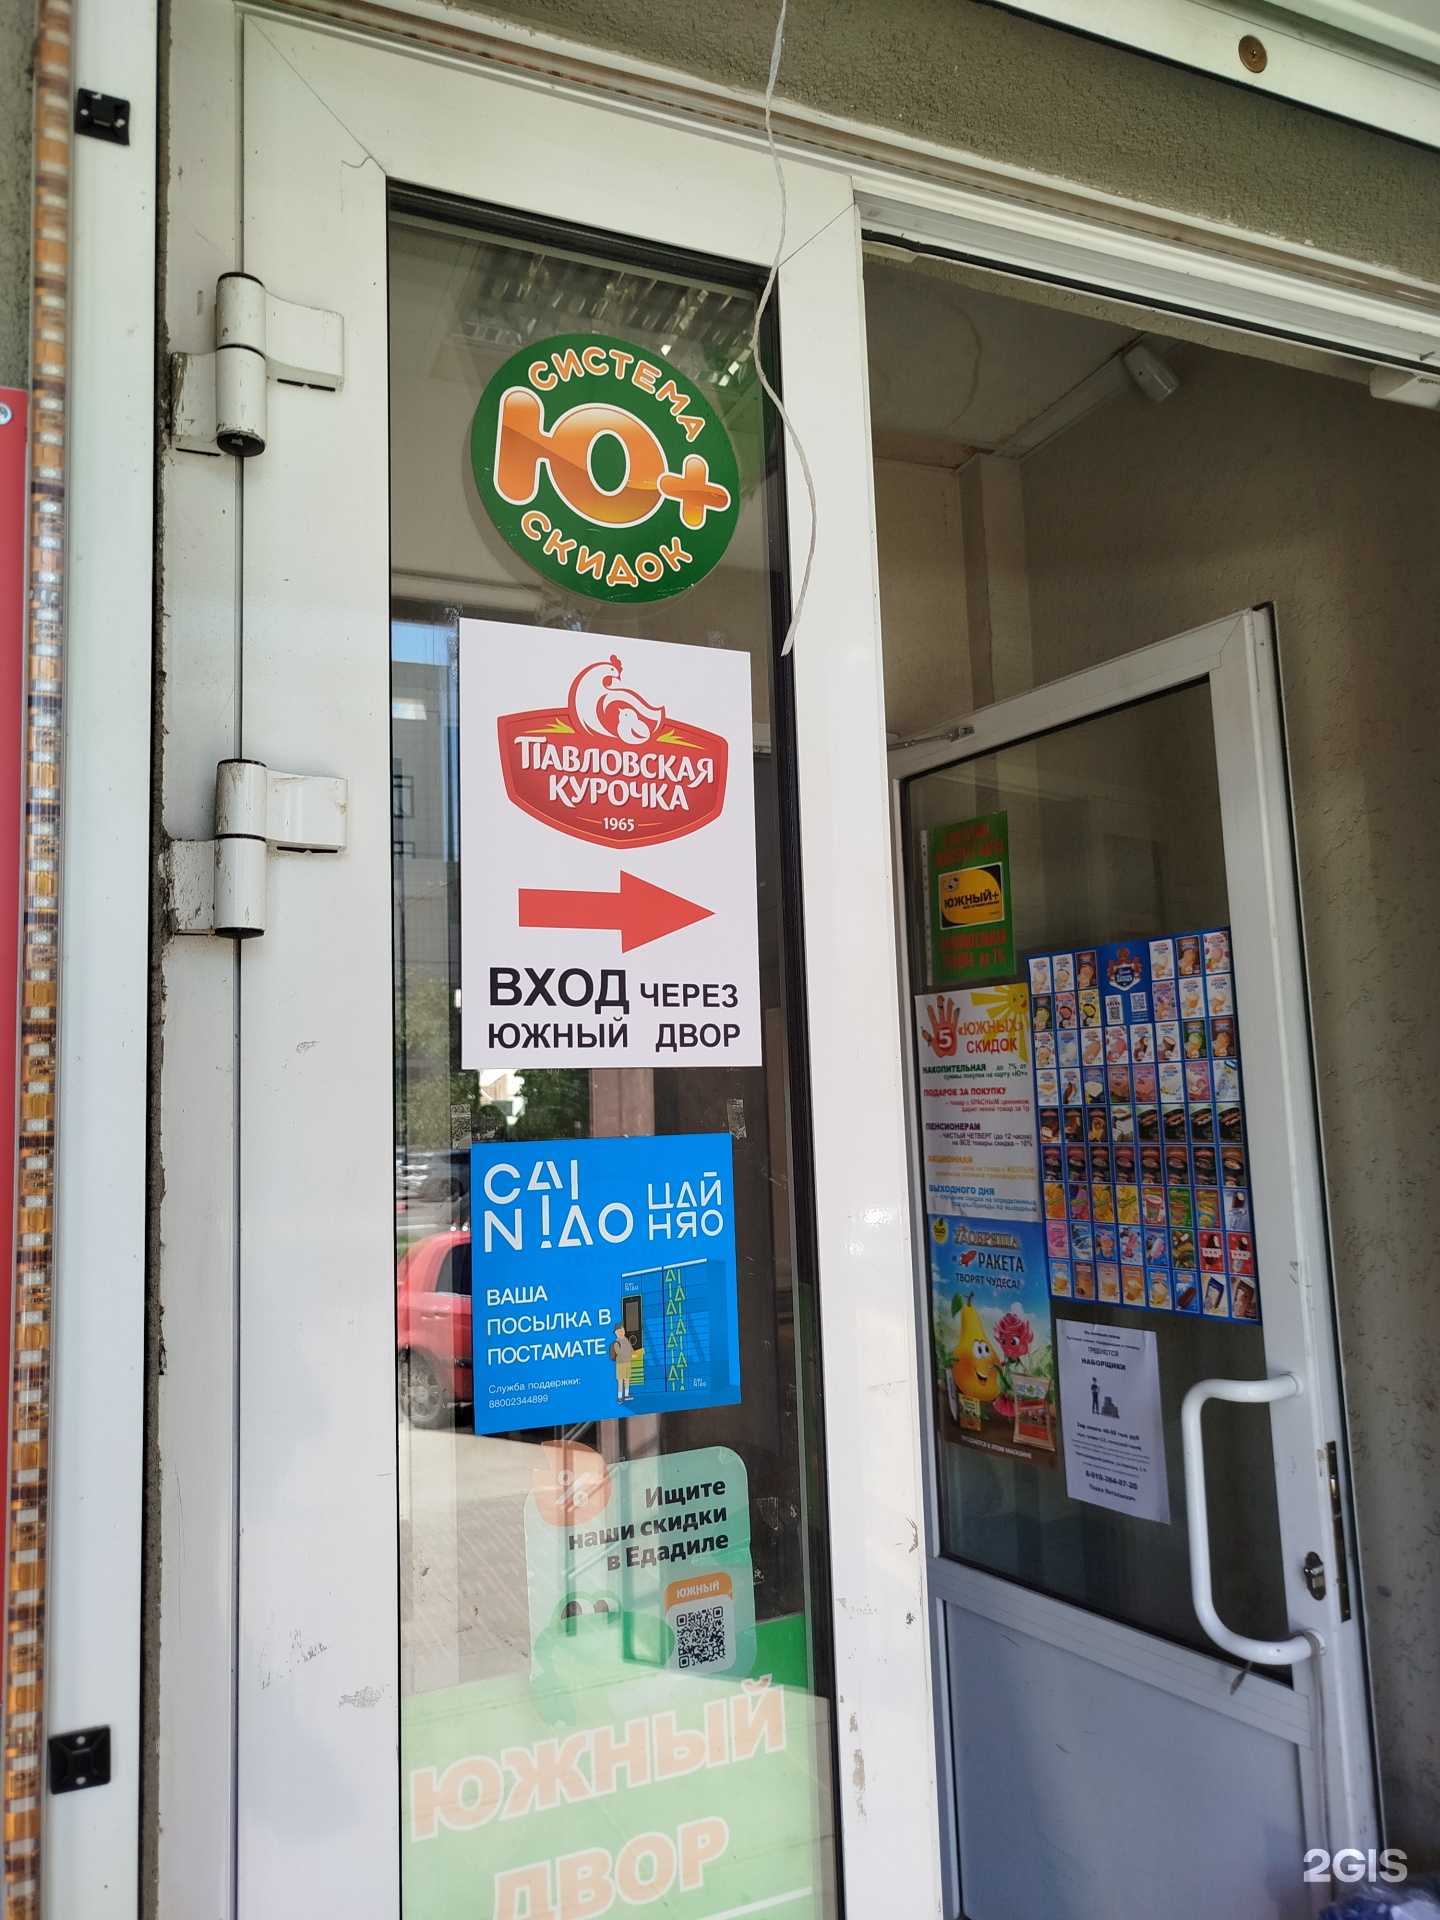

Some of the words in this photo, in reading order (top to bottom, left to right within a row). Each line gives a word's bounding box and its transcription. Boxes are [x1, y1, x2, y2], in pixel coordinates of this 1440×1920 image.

[528, 346, 705, 442] СИСТЕМА
[521, 510, 693, 587] СКИДОК
[514, 735, 714, 788] ПАВЛОВСКАЯ
[549, 775, 689, 811] КУРОЧКА
[603, 816, 635, 832] 1965
[488, 966, 630, 1014] ВХОД
[639, 982, 739, 1008] ЧЕРЕЗ
[488, 1016, 628, 1049] ЮЖНЫЙ
[655, 1022, 741, 1053] ДВОР
[938, 1029, 953, 1048] 5
[966, 1038, 1018, 1055] СКИДОК
[960, 1088, 969, 1096] ЗА
[971, 1087, 1006, 1096] ПОКУПКУ
[926, 1122, 980, 1130] ПЕНСИОНЕРАМ
[484, 1159, 579, 1205] CAI
[648, 1171, 722, 1211] ЦАЙ
[649, 1208, 724, 1241] НЯО
[956, 1272, 985, 1285] ТВОРЯТ
[978, 1252, 1025, 1273] РАКЕТА
[486, 1285, 548, 1307] ВАША
[487, 1310, 592, 1336] ПОСЫЛКА
[598, 1308, 612, 1325] В
[487, 1338, 606, 1366] ПОСТАМАТЕ
[488, 1382, 526, 1396] Служба
[645, 1478, 727, 1508] Ищите
[568, 1523, 635, 1551] наши
[641, 1506, 728, 1537] скидки
[606, 1552, 620, 1572] в
[626, 1532, 729, 1568] Едадиле
[410, 1674, 787, 1842] ЮЖНЫЙ
[491, 1815, 729, 1920] ДВОР
